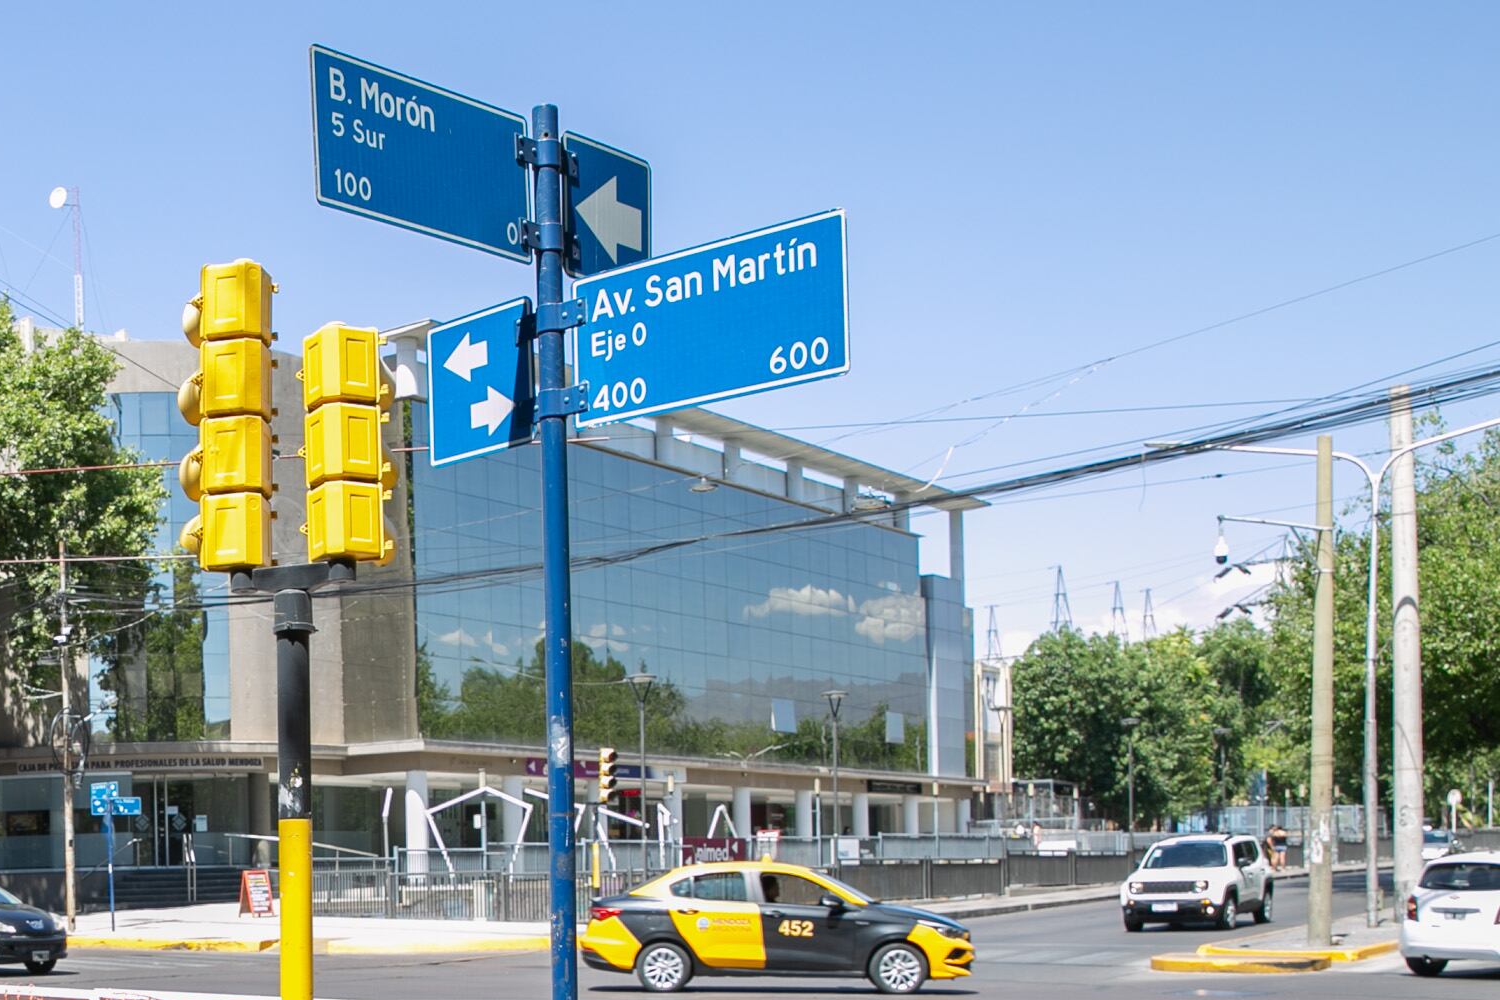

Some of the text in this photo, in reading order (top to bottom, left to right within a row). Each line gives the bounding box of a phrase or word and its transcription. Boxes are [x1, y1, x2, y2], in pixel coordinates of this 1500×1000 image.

[329, 66, 435, 133] B. Morón
[331, 112, 386, 150] 5 Sur
[334, 168, 372, 201] 100
[591, 238, 818, 323] Av. San Martín
[591, 322, 647, 361] Eje 0
[769, 336, 829, 375] 600
[592, 377, 647, 412] 400
[115, 758, 177, 769] PROFESIONALES
[179, 758, 189, 768] DE
[191, 757, 200, 767] LA
[202, 757, 226, 767] SALUD
[228, 756, 262, 766] MENDOZA
[778, 919, 814, 937] 452
